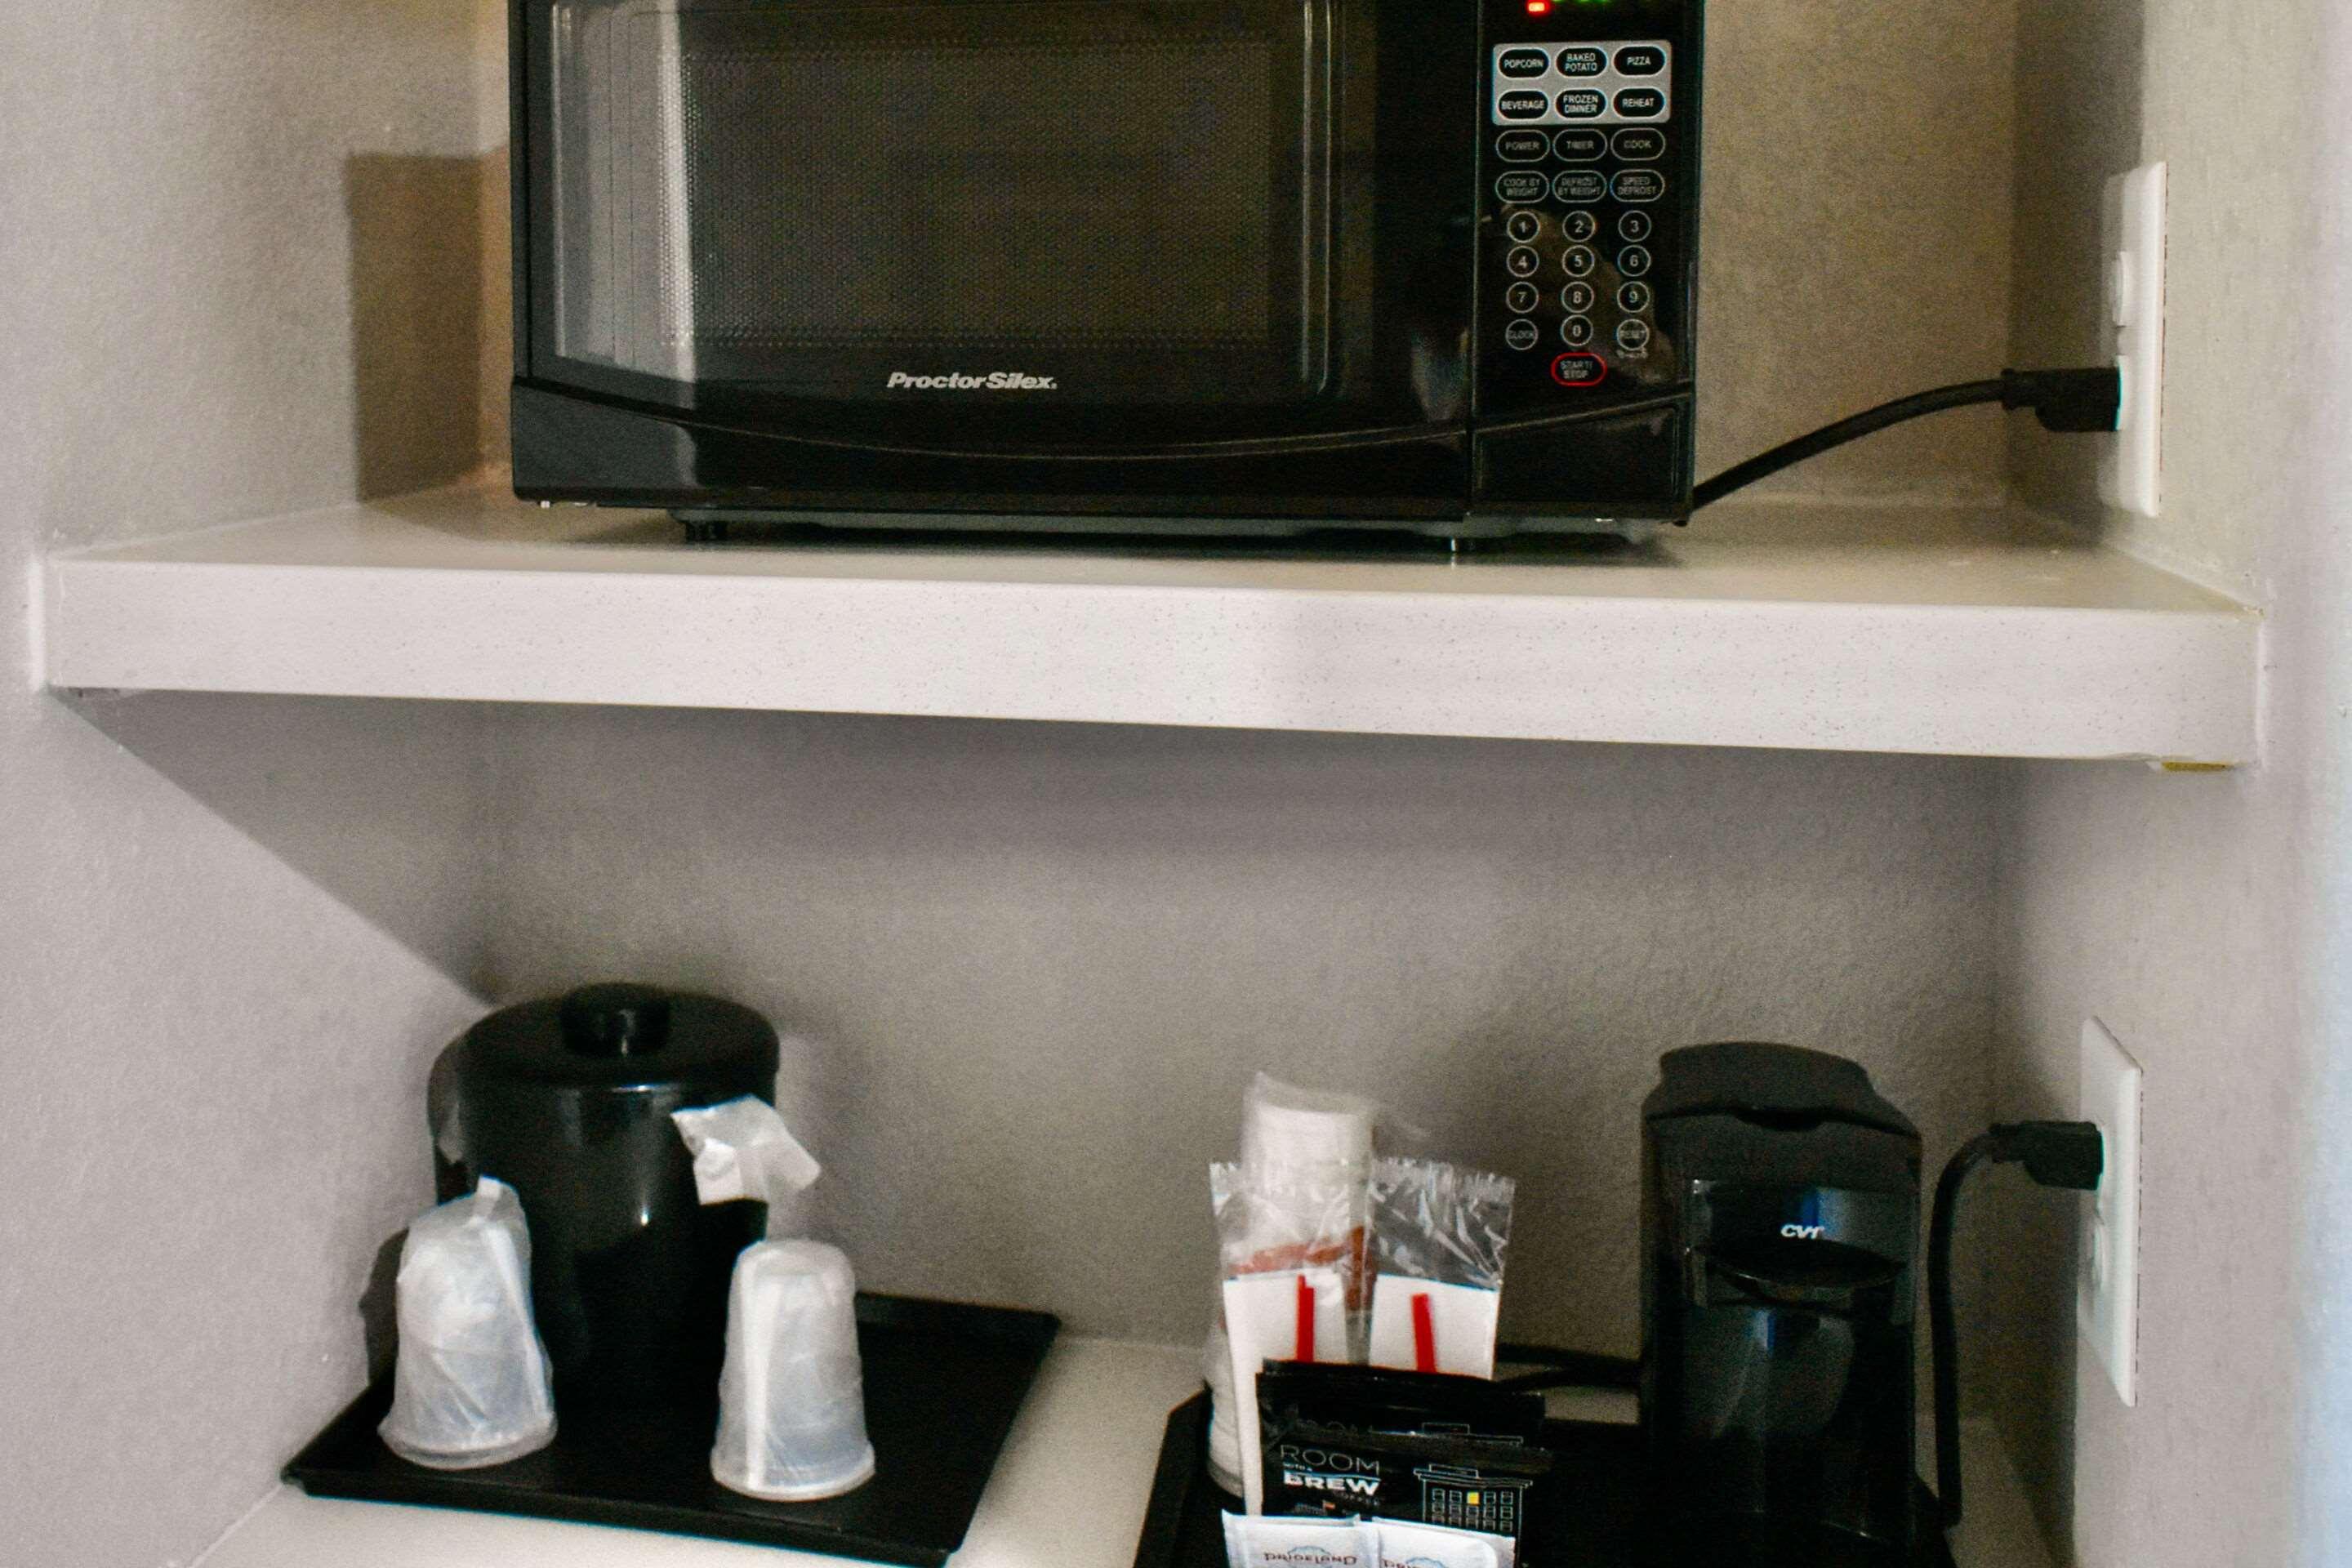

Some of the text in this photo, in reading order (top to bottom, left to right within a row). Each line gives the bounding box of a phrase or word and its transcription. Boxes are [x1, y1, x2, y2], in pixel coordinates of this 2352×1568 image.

[1566, 53, 1596, 62] BAKED
[1627, 56, 1651, 66] PIZZA
[1503, 59, 1544, 69] POPCORN
[1565, 63, 1597, 72] POTATO
[1563, 95, 1598, 104] FROZEN
[1622, 98, 1655, 108] REHEAT
[1501, 100, 1545, 110] BEVERAGE
[1564, 105, 1597, 114] DINNER
[1505, 140, 1540, 150] POWER
[1566, 140, 1595, 149] TIMER
[1624, 140, 1652, 149] COOK
[1518, 221, 1527, 233] 1
[1575, 220, 1584, 233] 2
[1630, 220, 1639, 233] 3
[1518, 256, 1528, 268] 4
[1574, 255, 1583, 267] 5
[1629, 254, 1638, 266] 6
[1517, 292, 1526, 303] 7
[1573, 291, 1582, 304] 8
[1628, 291, 1638, 303] 9
[1572, 324, 1582, 336] 0
[1563, 370, 1588, 380] STOP
[1281, 1444, 1380, 1475] ROOM
[1283, 1470, 1382, 1496] BREW
